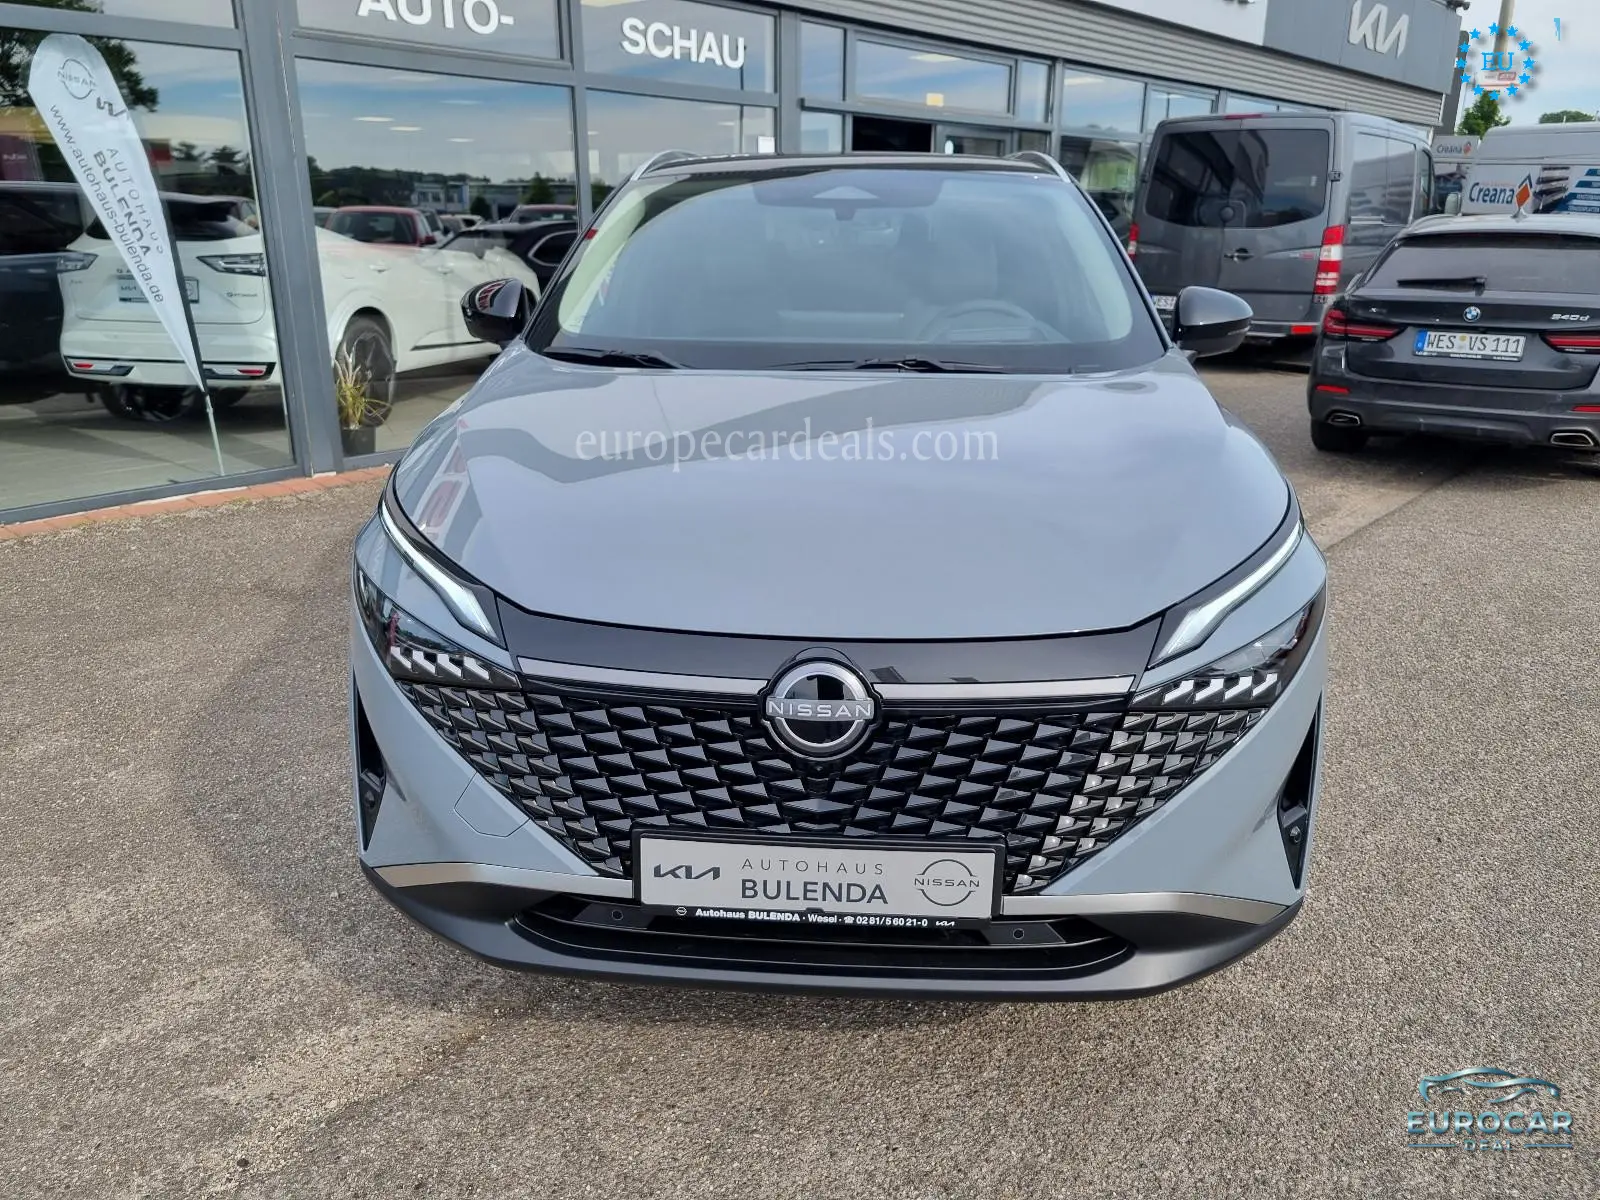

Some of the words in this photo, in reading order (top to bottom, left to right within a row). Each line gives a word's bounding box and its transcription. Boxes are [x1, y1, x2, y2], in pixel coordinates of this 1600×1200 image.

[621, 17, 745, 69] SCHAU
[57, 70, 97, 88] NISSAN
[1437, 144, 1463, 154] Creana
[1468, 182, 1515, 205] Creana
[50, 104, 164, 303] www.autohaus-bulenda.de
[1427, 333, 1457, 350] WES
[1469, 335, 1488, 351] VS
[1491, 337, 1521, 354] 111
[768, 701, 872, 718] NISSAN
[653, 864, 721, 880] KIA
[741, 858, 884, 875] AUTOHAUS
[914, 877, 980, 888] NISSAN
[741, 878, 889, 905] BULENDA
[695, 908, 745, 918] Autohaus
[748, 911, 800, 921] BULENDA
[807, 913, 837, 923] Wesel
